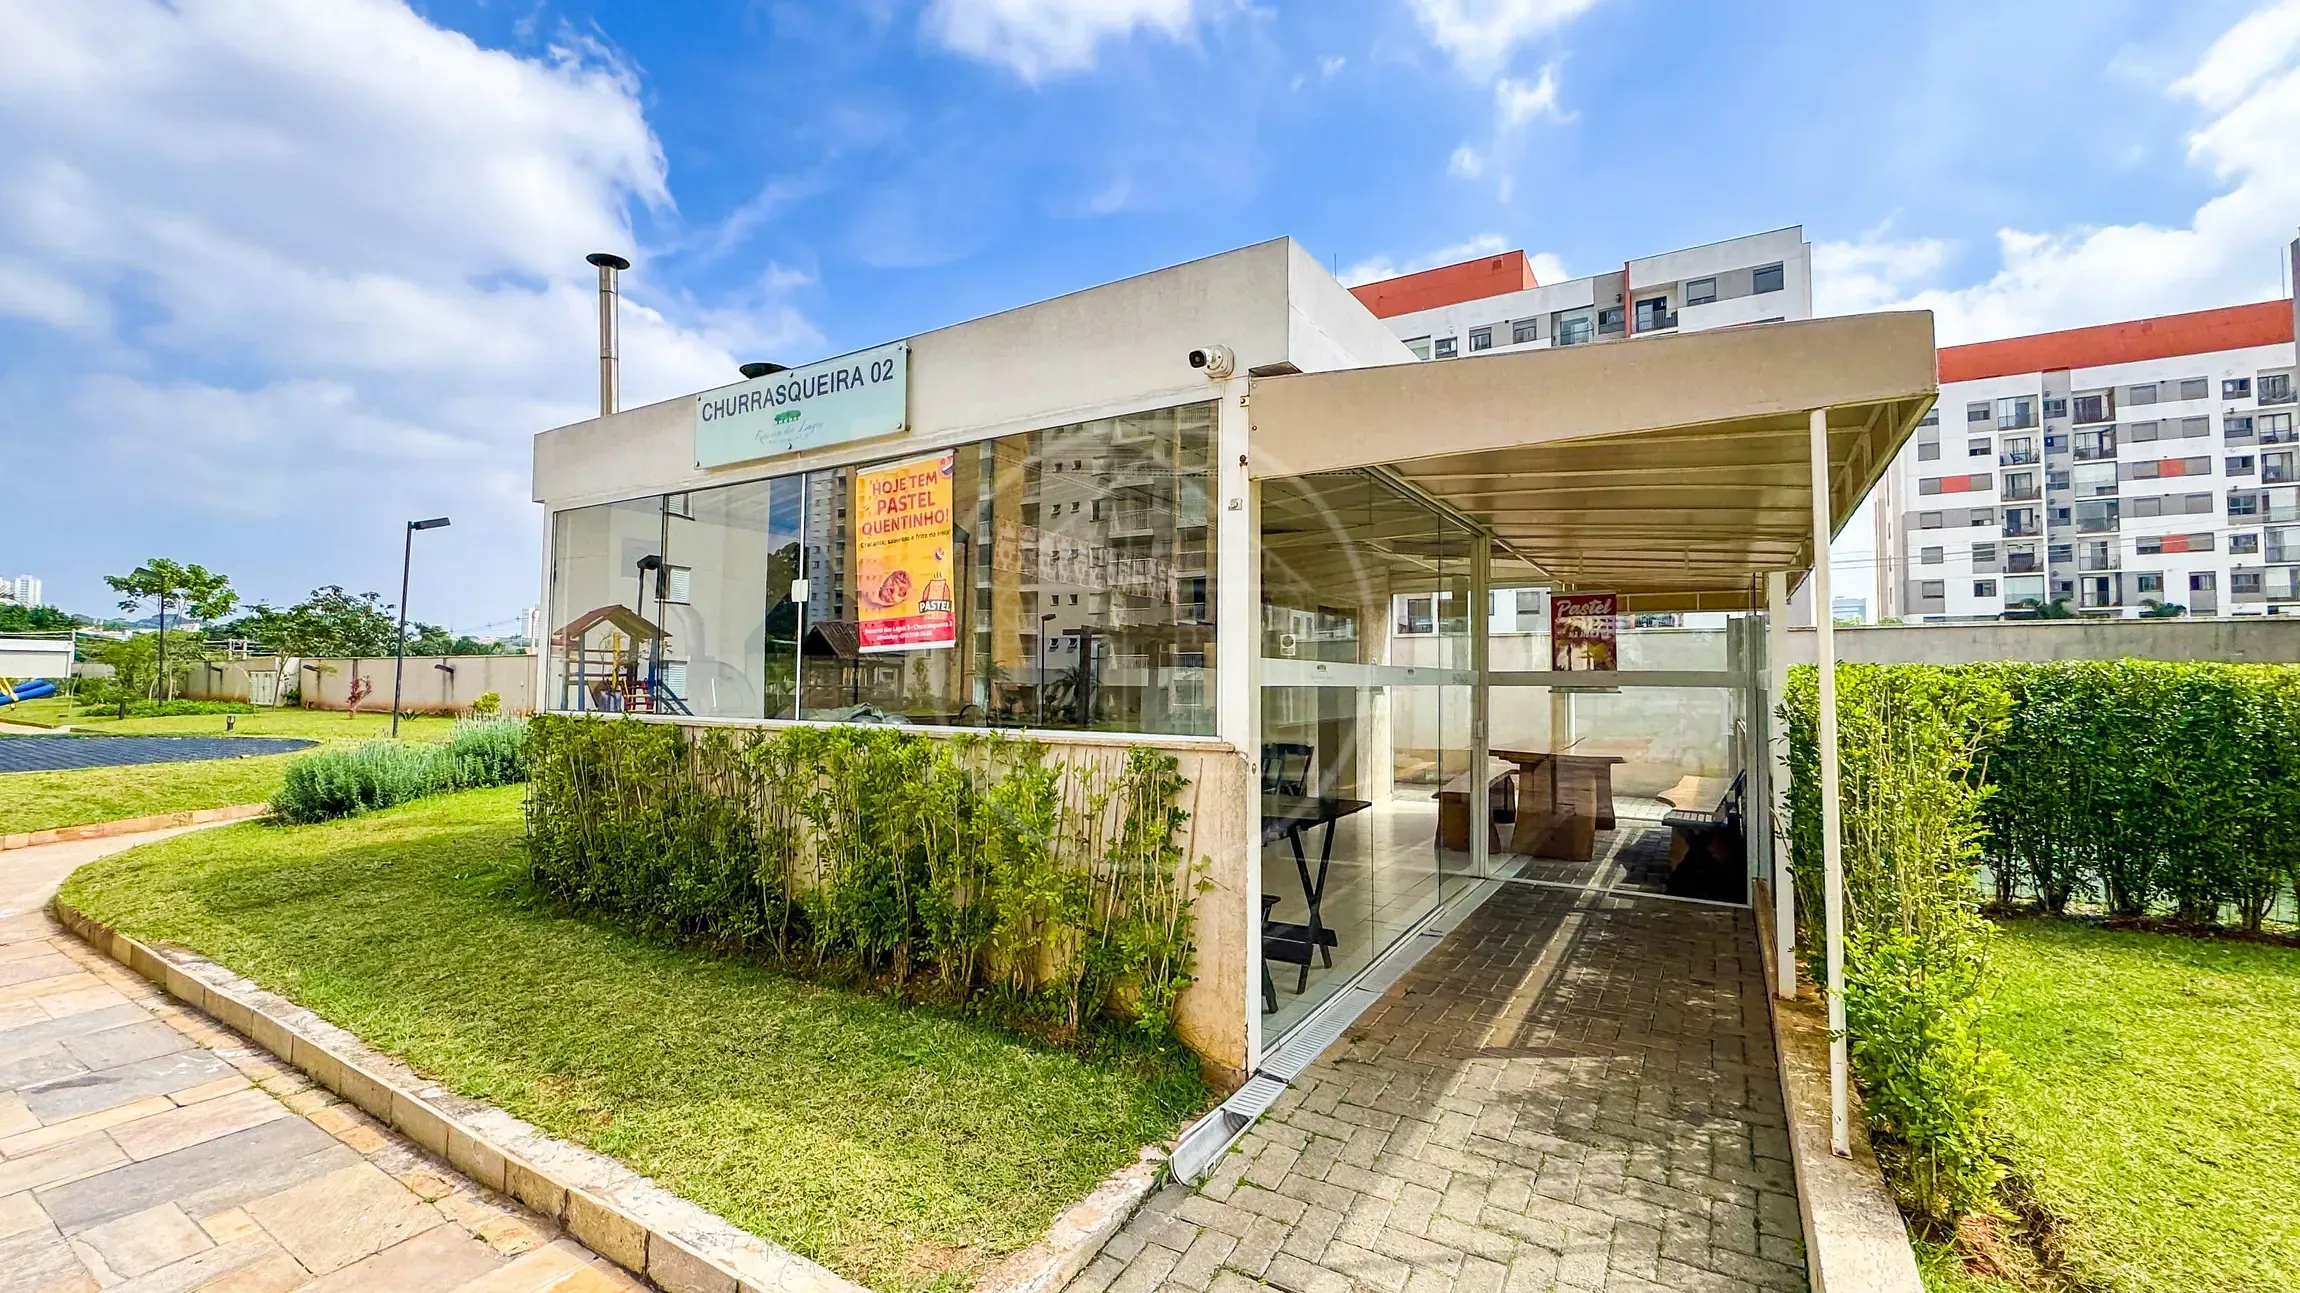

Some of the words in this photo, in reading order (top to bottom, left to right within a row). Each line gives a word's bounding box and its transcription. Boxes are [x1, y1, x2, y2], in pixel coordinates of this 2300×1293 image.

[702, 366, 864, 422] CHURRASQUEIRA
[871, 359, 893, 384] 02
[872, 477, 906, 496] HOJE
[909, 471, 937, 489] TEM
[877, 491, 936, 516] PASTEL
[862, 508, 949, 537] QUENTINHO!
[920, 601, 951, 612] PASTEL
[1556, 599, 1612, 623] Pastel
